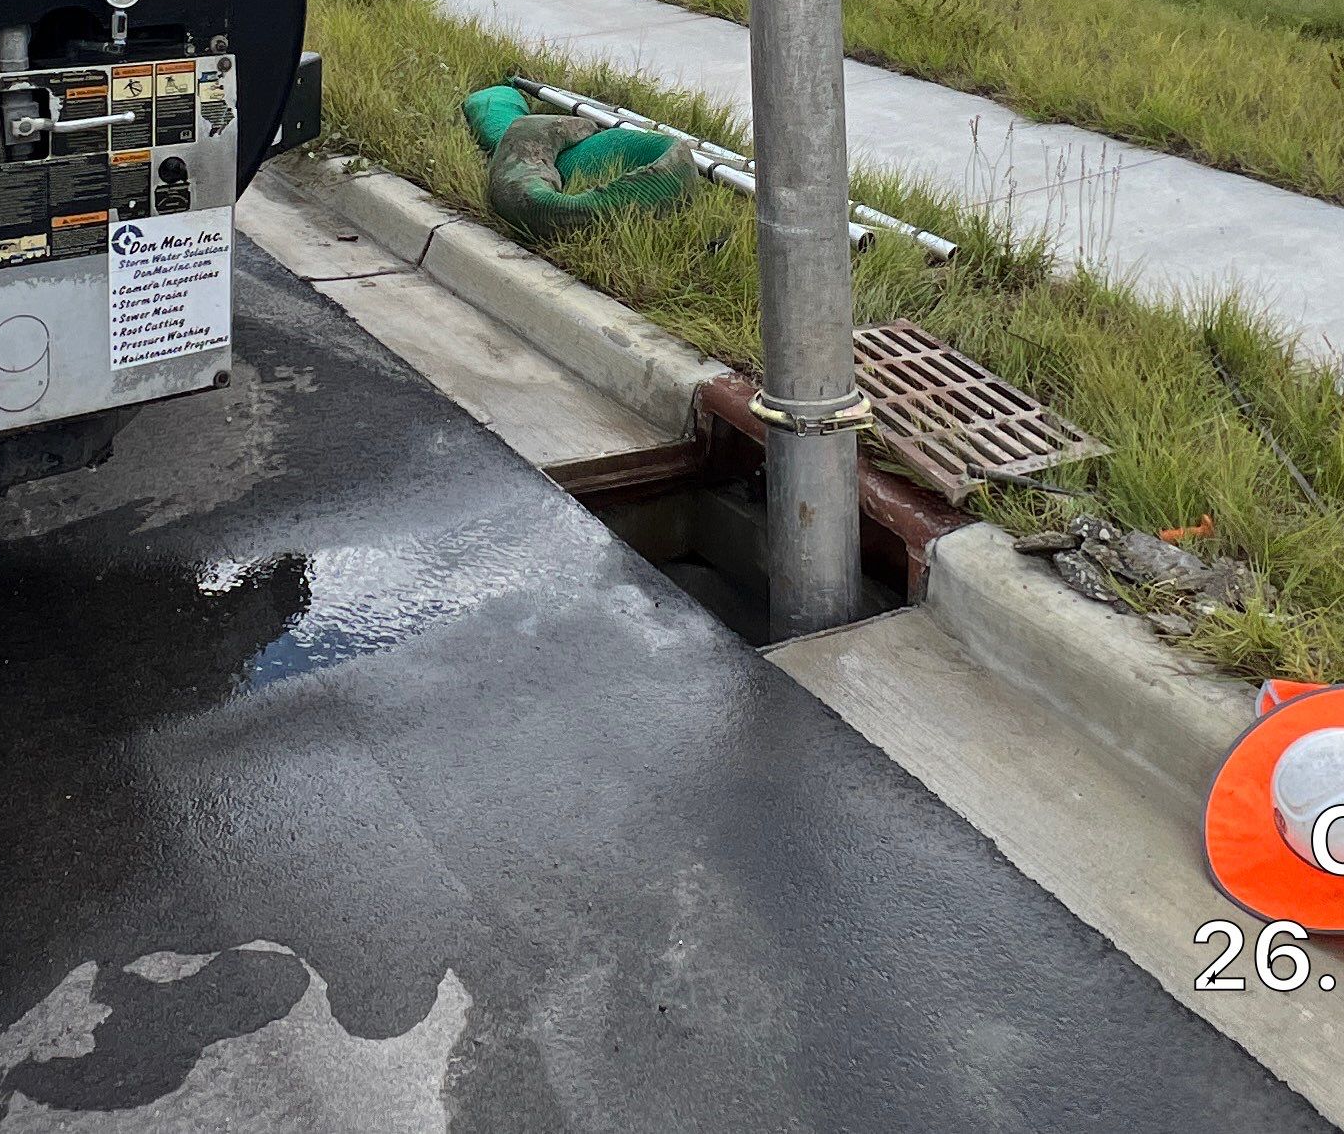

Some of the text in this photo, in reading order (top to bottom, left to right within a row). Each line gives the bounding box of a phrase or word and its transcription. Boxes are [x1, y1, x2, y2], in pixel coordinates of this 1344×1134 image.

[129, 231, 223, 255] Don Mar, Inc.
[118, 244, 229, 269] Storm Water Solutions
[118, 270, 219, 296] Camera Inspections
[119, 290, 188, 310] Storm Drains
[119, 304, 185, 324] Sewer Mains
[119, 318, 186, 337] Root Cutting
[120, 326, 210, 351] Pressure Washing
[119, 335, 229, 364] Maintenance Programs
